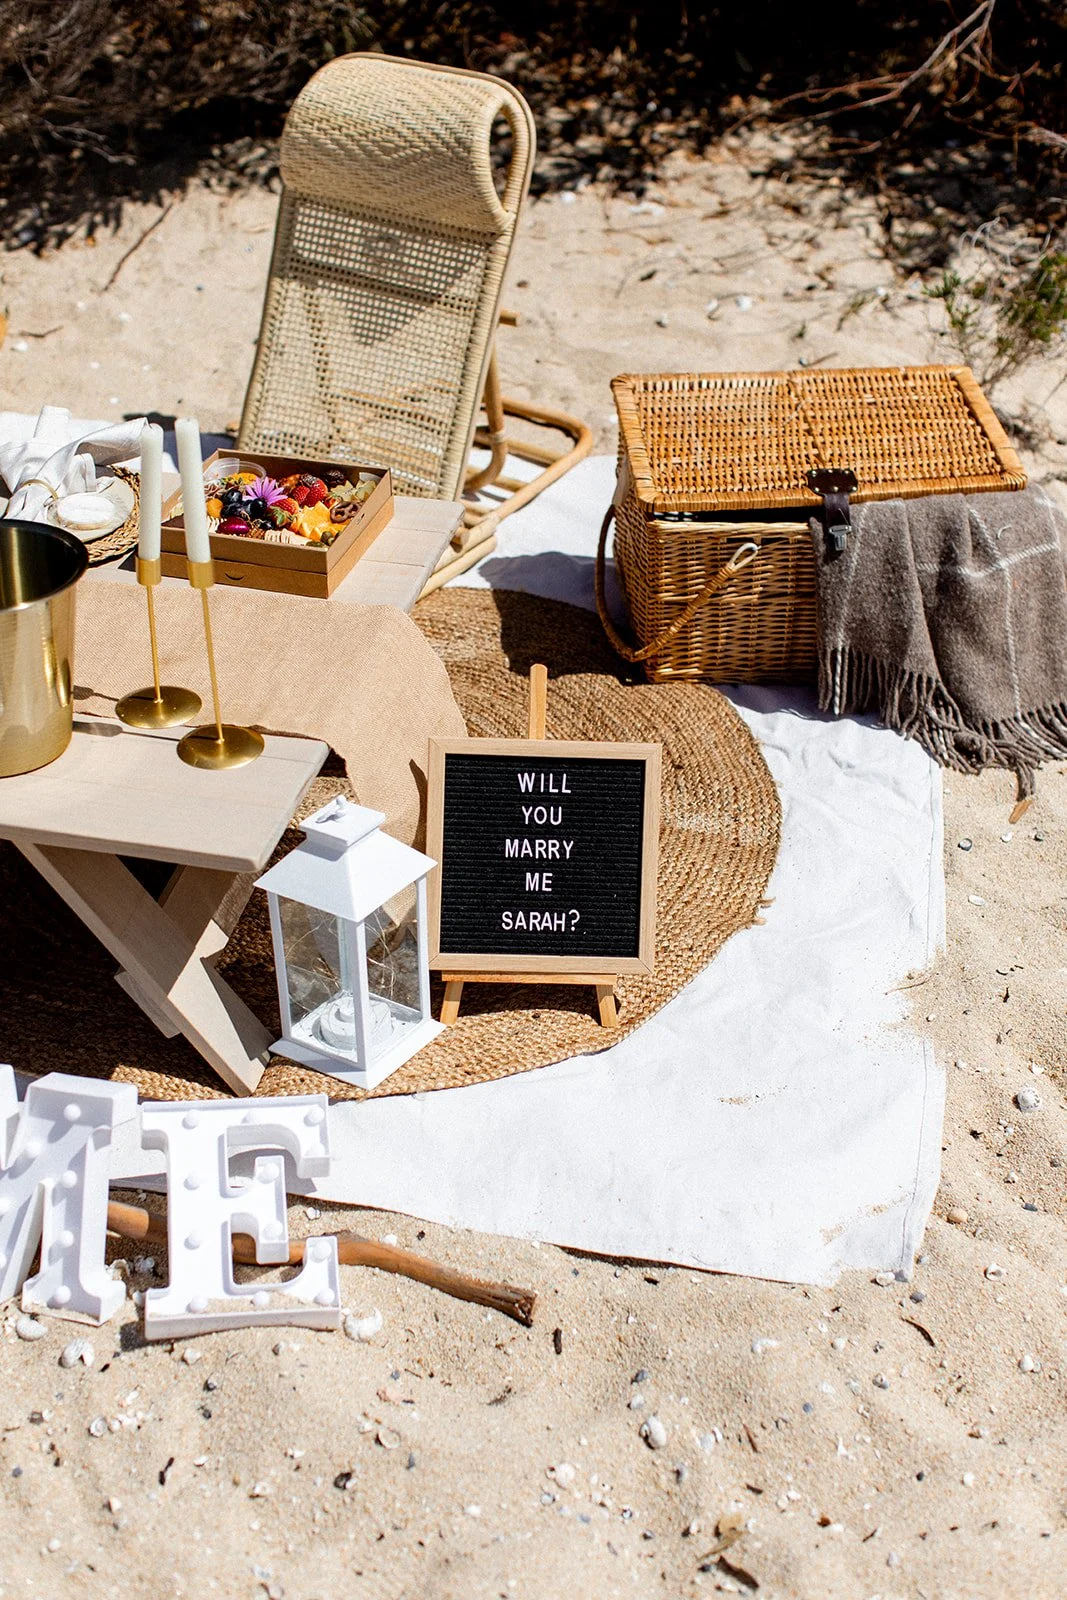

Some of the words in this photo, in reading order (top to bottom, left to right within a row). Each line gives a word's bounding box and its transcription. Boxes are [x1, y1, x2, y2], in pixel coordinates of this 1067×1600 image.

[517, 772, 572, 794] WILL
[521, 805, 562, 826] YOU
[504, 838, 574, 860] MARRY
[525, 872, 553, 892] ME
[501, 908, 581, 932] SARAH?
